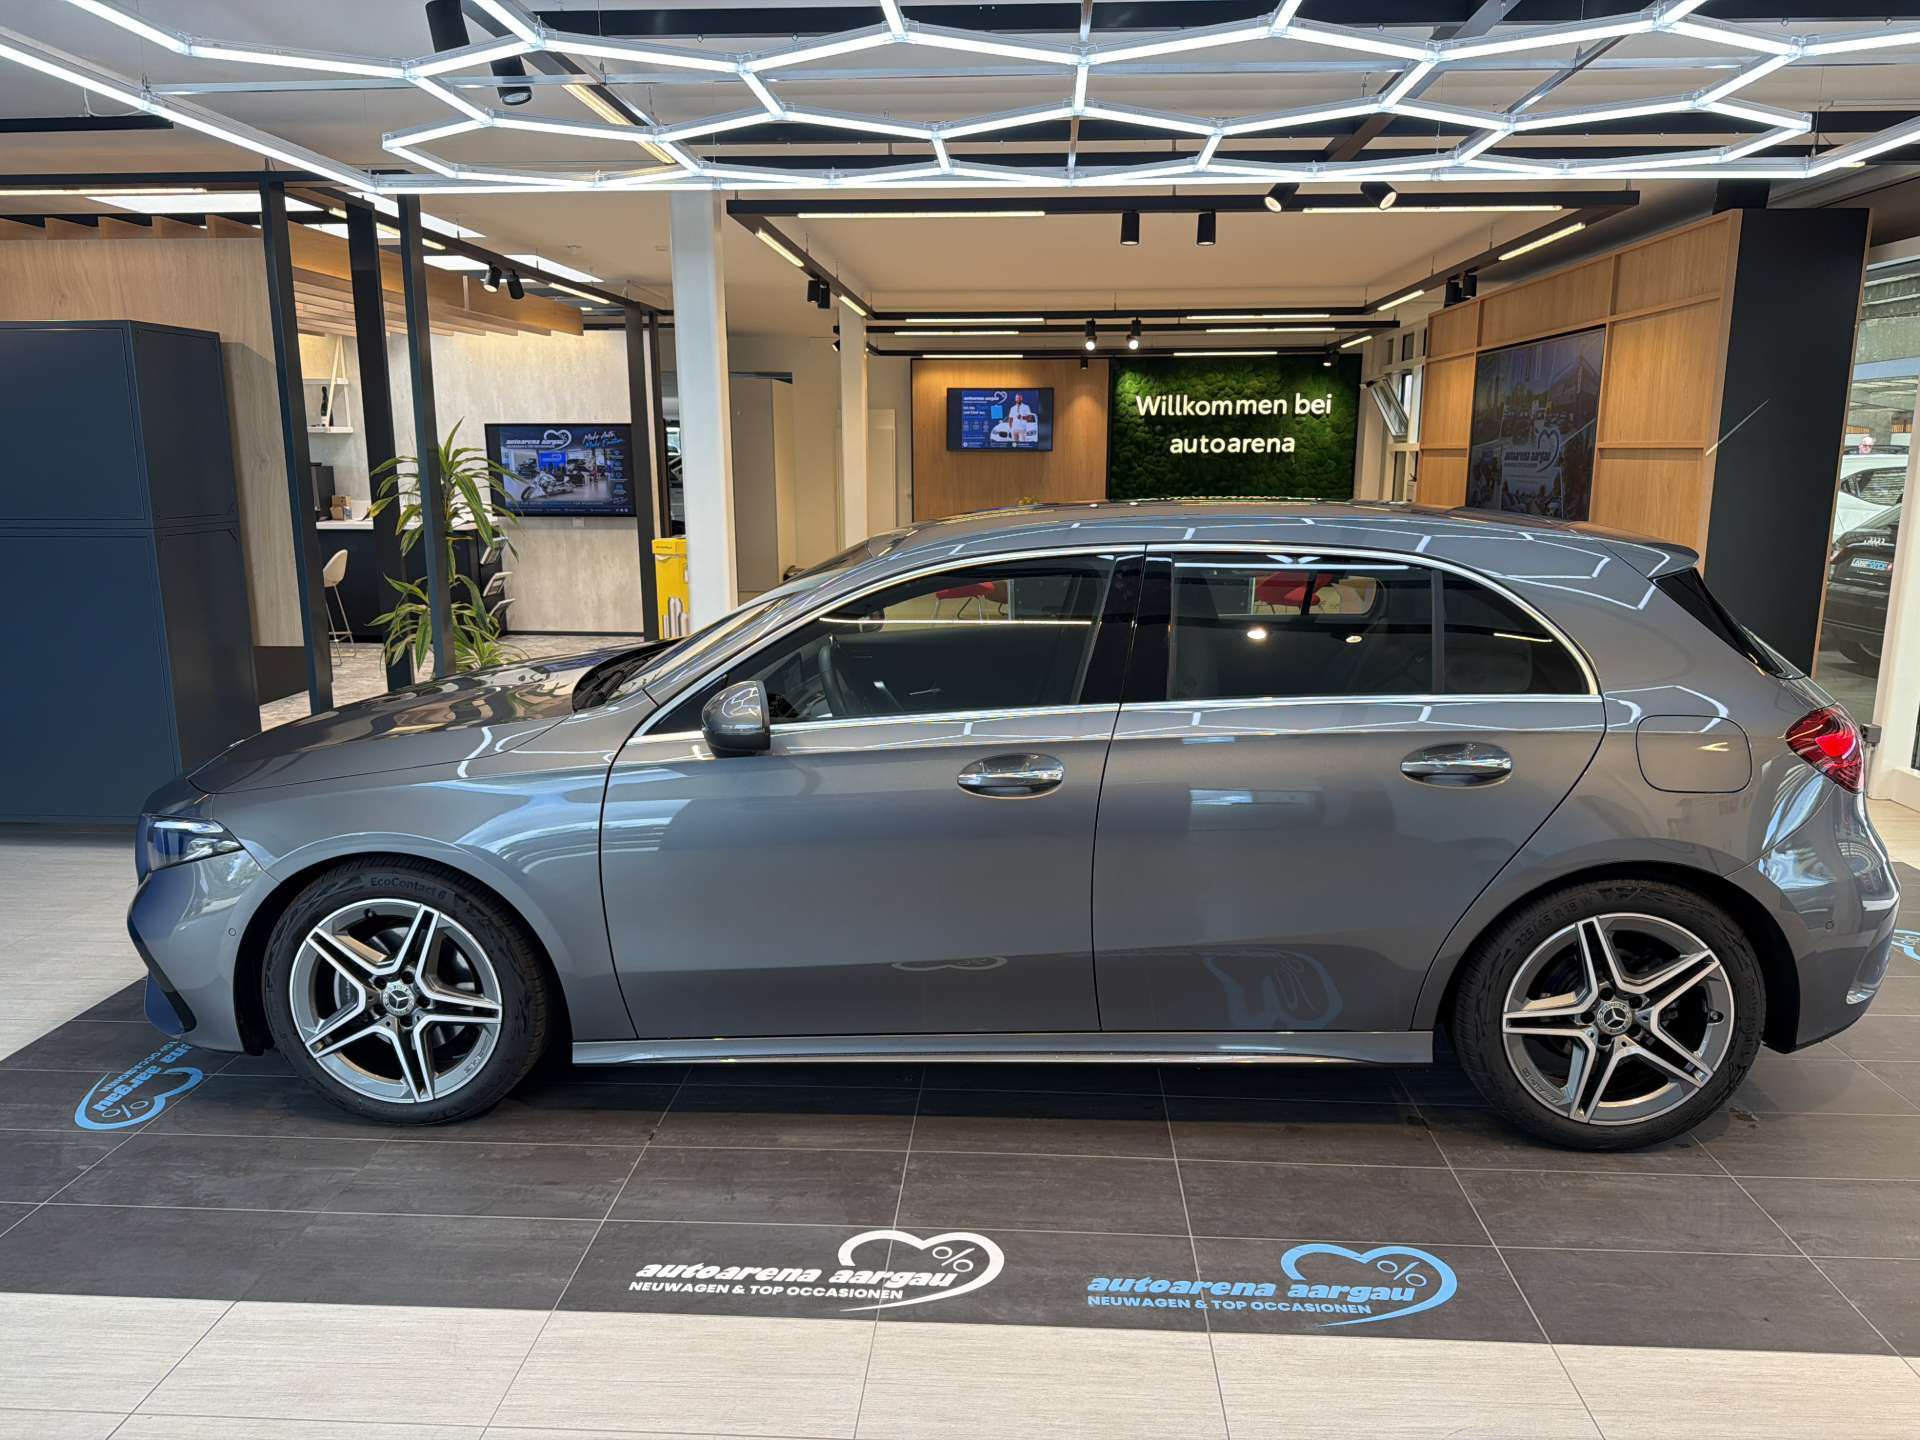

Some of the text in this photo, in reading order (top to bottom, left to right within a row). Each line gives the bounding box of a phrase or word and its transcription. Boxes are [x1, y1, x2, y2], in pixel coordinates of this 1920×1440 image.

[1136, 392, 1333, 416] Willkommen bei
[1169, 435, 1295, 454] autoarena
[370, 876, 438, 897] EcoContact
[635, 1262, 959, 1289] autoarena aargau
[628, 1280, 904, 1300] NEUWAGEN & TOP OCCASIONEN
[1087, 1275, 1417, 1302] autoarena aargau
[1087, 1294, 1372, 1315] NEUWAGEN & TOP OCCASIONEN
